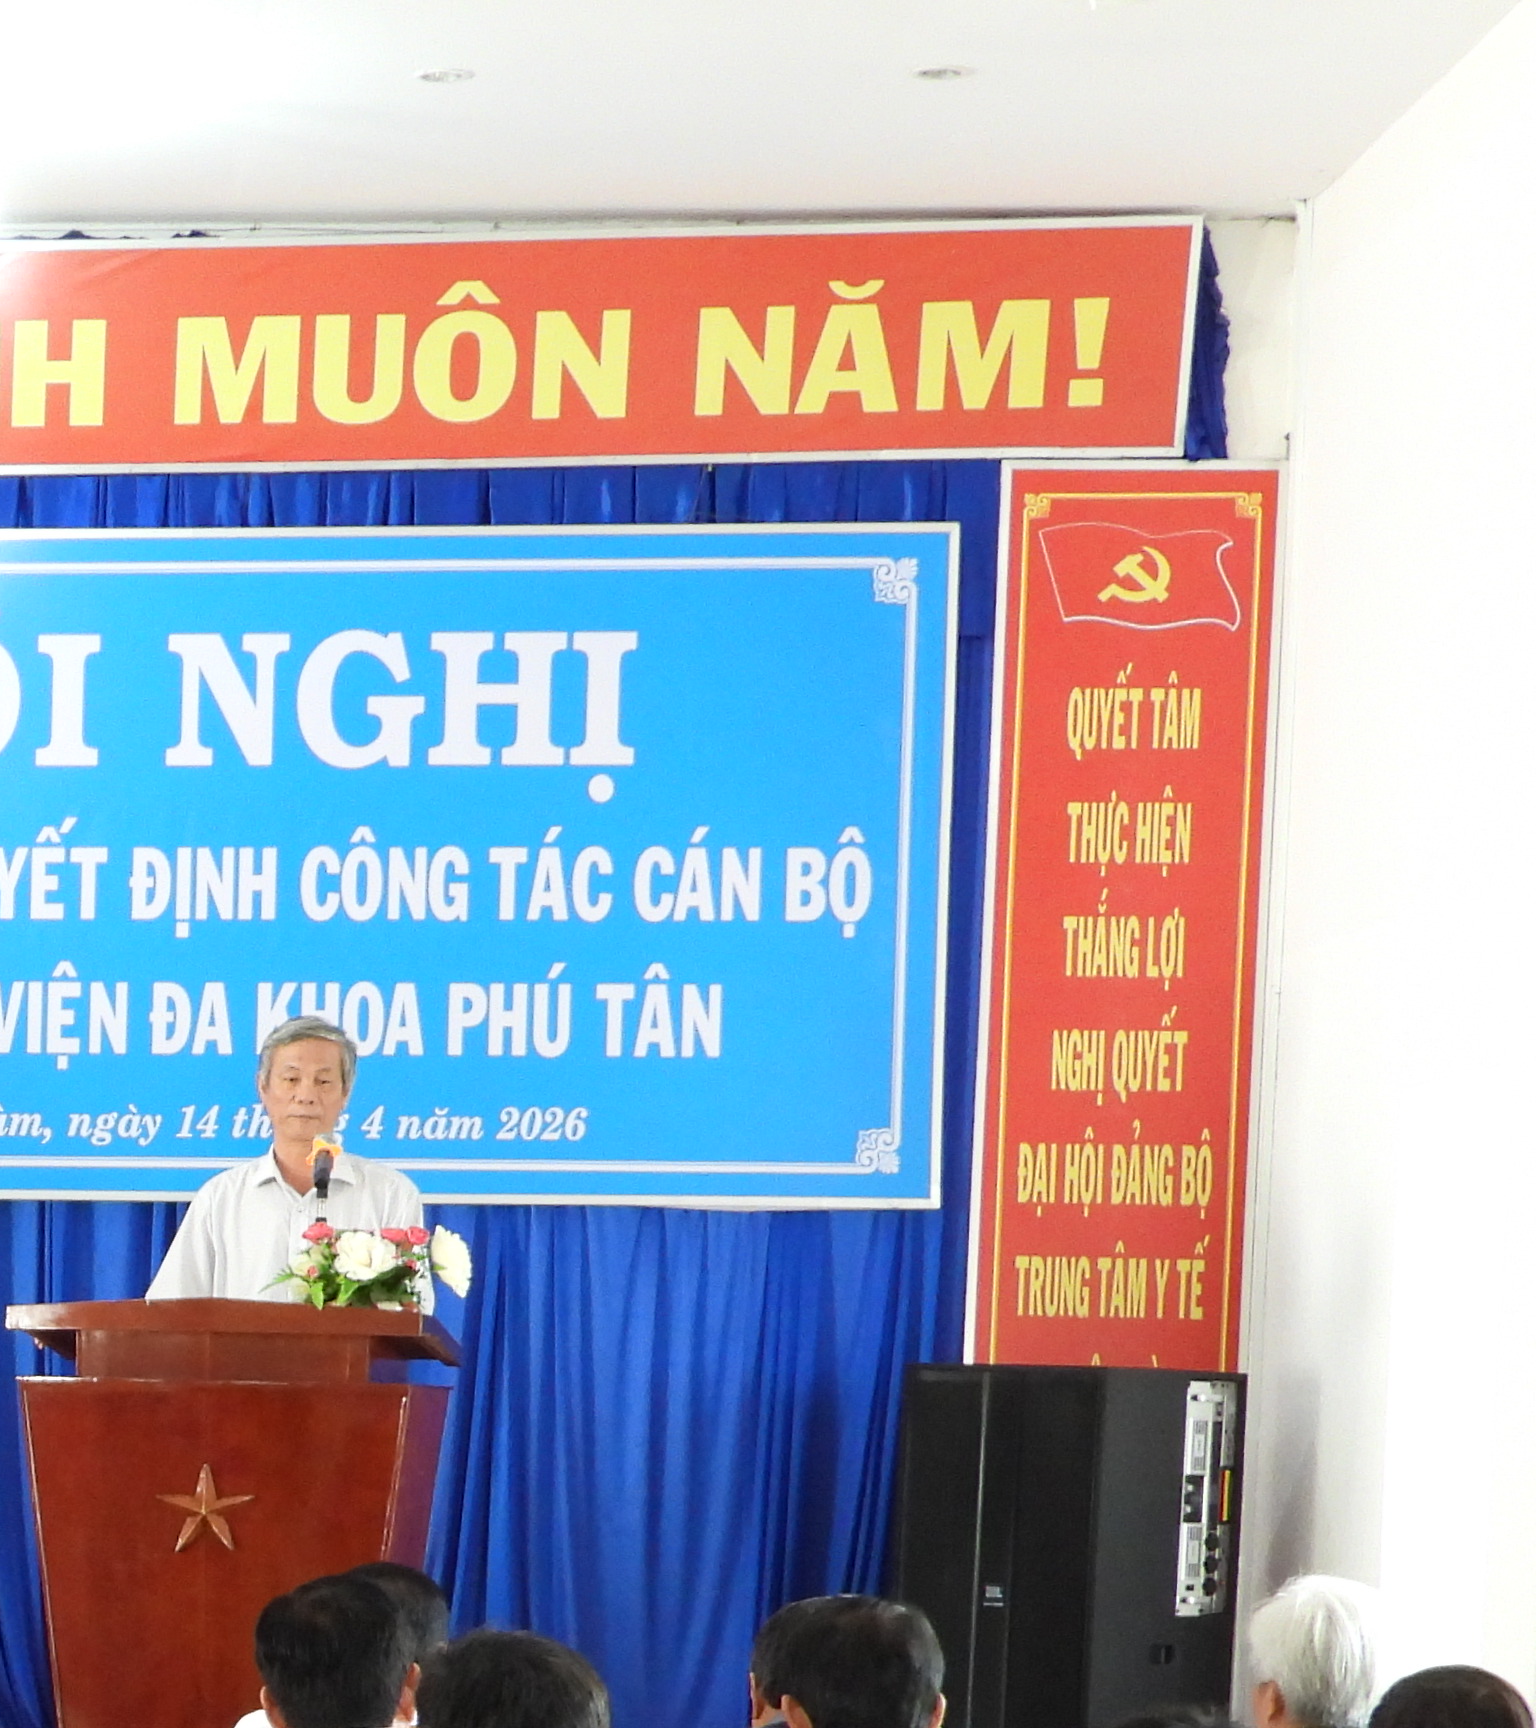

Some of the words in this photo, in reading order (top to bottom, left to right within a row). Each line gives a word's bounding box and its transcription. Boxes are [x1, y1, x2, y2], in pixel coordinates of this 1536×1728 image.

[174, 280, 634, 424] MUÔN
[695, 279, 1111, 415] NĂM!
[165, 629, 637, 802] NGHỊ
[1067, 662, 1143, 760] QUYẾT
[1148, 670, 1205, 749] TÂM
[1066, 790, 1131, 876] THỰC
[1134, 784, 1195, 877] HIỆN
[129, 847, 277, 938] ĐỊNH
[301, 826, 469, 921] CÔNG
[489, 826, 612, 922] TÁC
[634, 827, 761, 922] CÁN
[785, 827, 871, 938] BỘ
[1062, 888, 1140, 979] THẮNG
[1146, 907, 1186, 991] LỢI
[149, 982, 232, 1054] ĐA
[448, 963, 571, 1058] PHÚ
[596, 963, 721, 1057] TÂN
[1051, 1028, 1106, 1106] NGHỊ
[1111, 1005, 1188, 1102] QUYẾT
[68, 1104, 161, 1146] ngày
[176, 1106, 218, 1137] 14
[232, 1103, 349, 1145] thg
[361, 1106, 383, 1138] 4
[397, 1108, 483, 1139] năm
[496, 1107, 587, 1140] 2026
[1015, 1141, 1060, 1216] ĐẠI
[1062, 1126, 1108, 1216] HỘI
[1110, 1118, 1176, 1208] ĐẢNG
[1179, 1128, 1213, 1219] BỘ
[1015, 1255, 1093, 1318] TRUNG
[1097, 1240, 1149, 1319] TÂM
[1155, 1258, 1171, 1318] Y
[1176, 1234, 1210, 1320] TẾ
